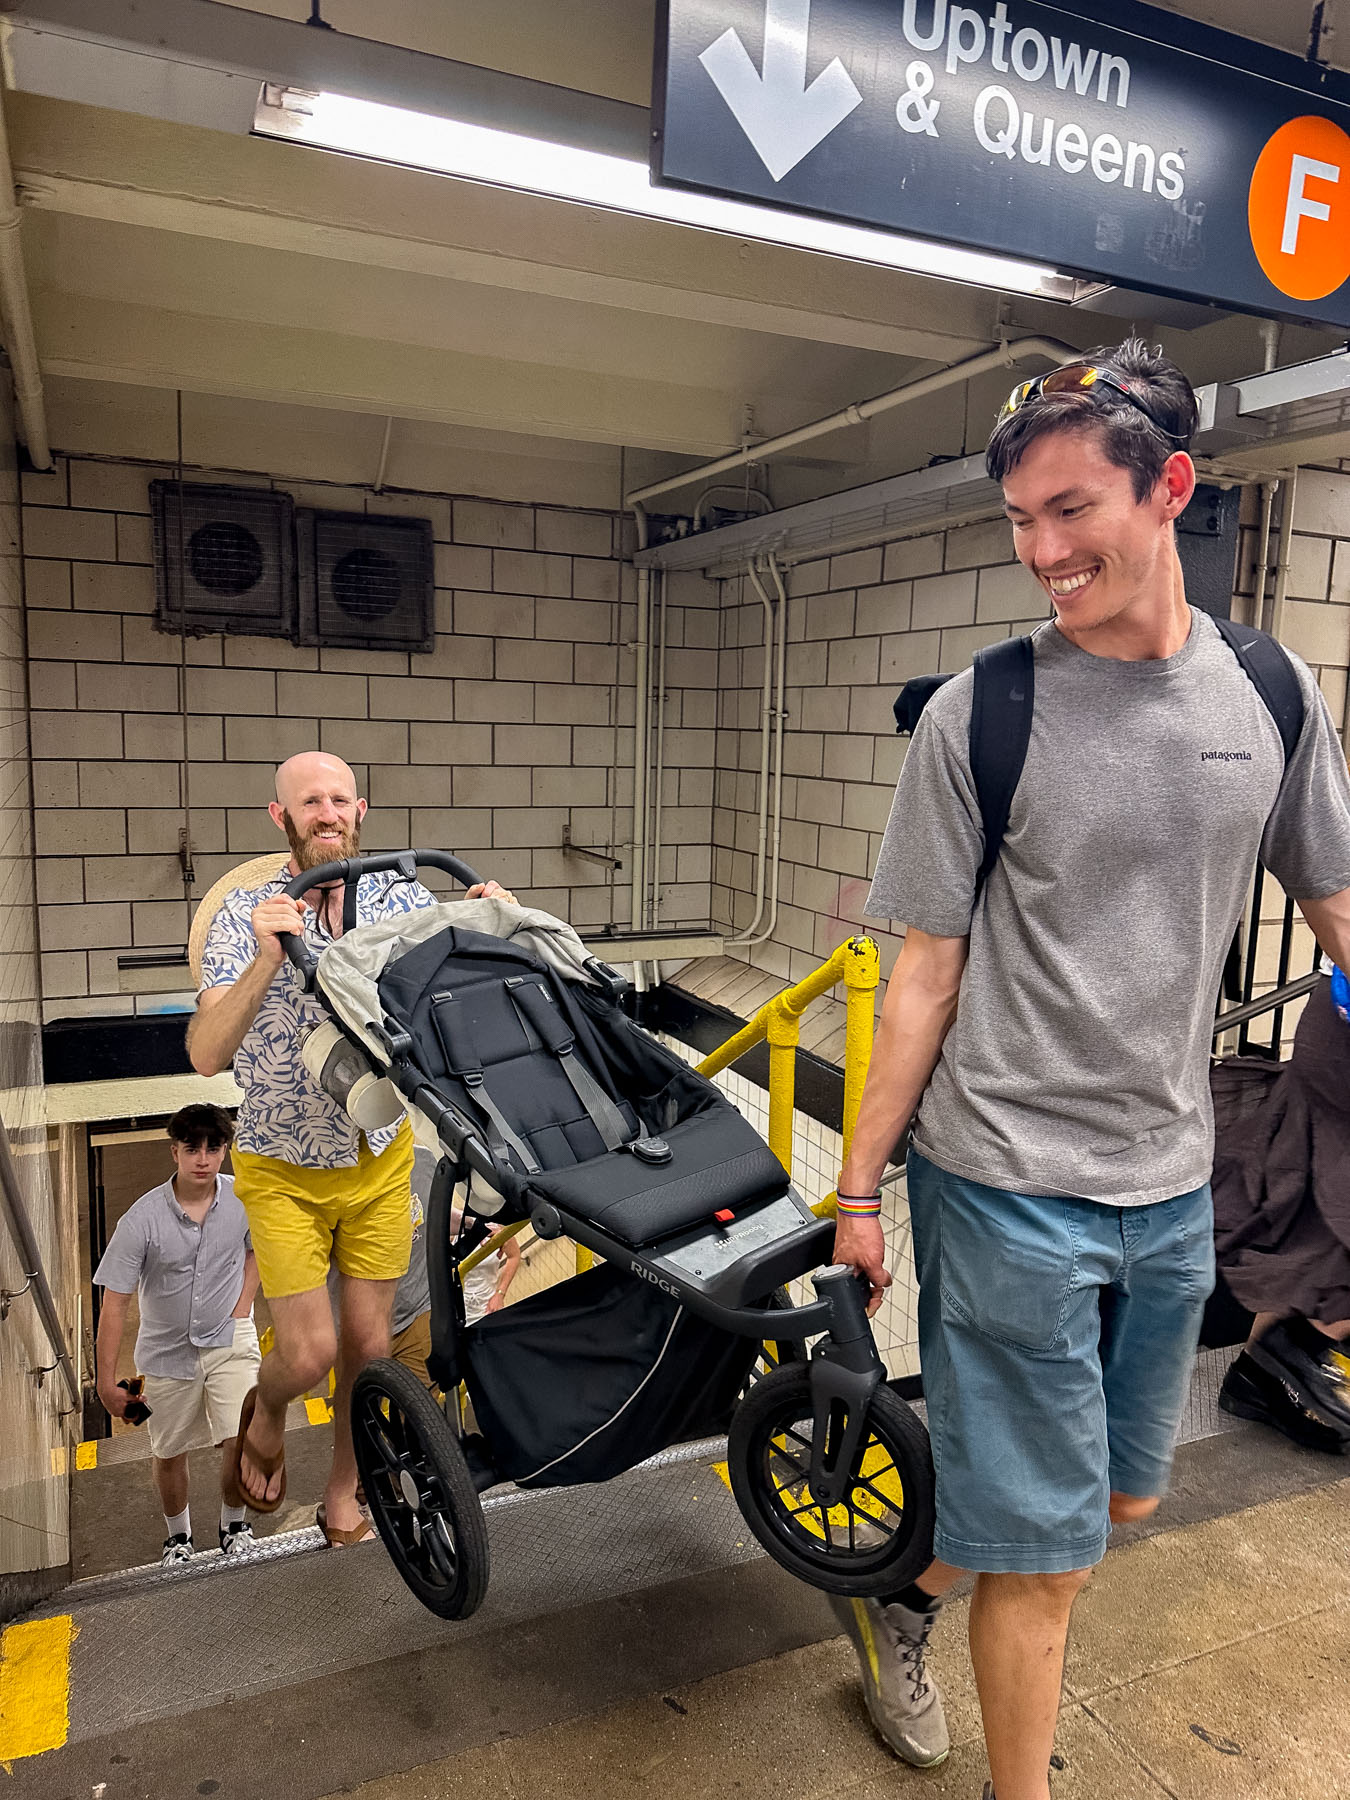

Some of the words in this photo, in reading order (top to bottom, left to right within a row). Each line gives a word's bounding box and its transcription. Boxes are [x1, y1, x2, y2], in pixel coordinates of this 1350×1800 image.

[902, 0, 1131, 108] Uptown
[896, 60, 941, 138] &
[973, 84, 1186, 200] Queens
[1280, 153, 1340, 255] F
[1200, 750, 1252, 762] patagonia
[630, 1260, 681, 1299] RIDGE
